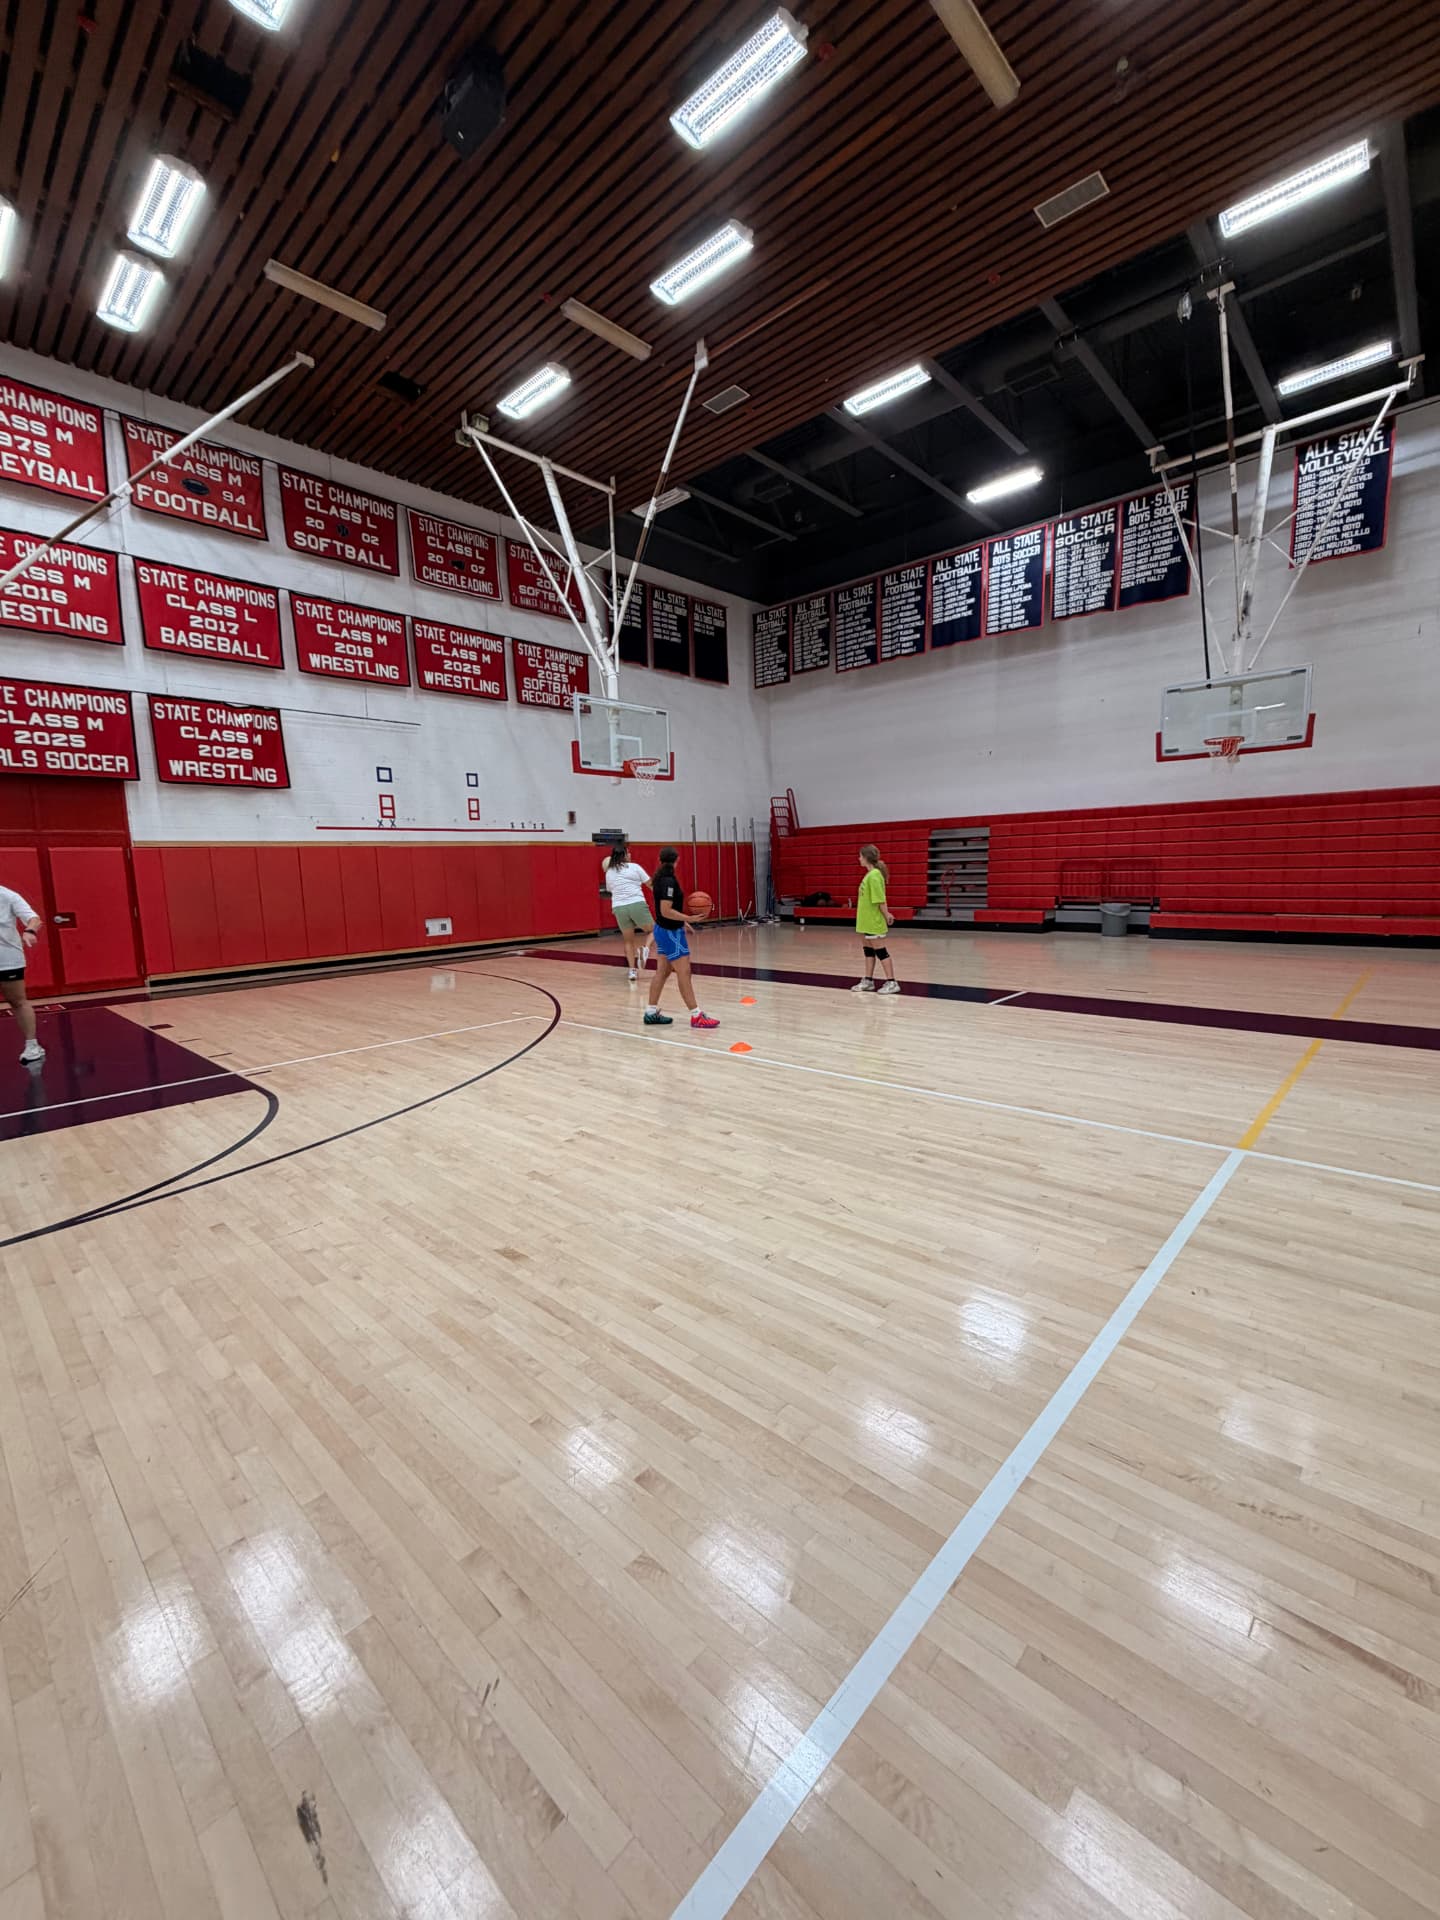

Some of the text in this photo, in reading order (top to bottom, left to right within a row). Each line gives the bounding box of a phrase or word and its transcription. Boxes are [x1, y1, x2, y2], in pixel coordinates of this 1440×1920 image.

[0, 386, 97, 433] HAMPIONS
[56, 427, 73, 445] M
[126, 422, 174, 450] STATE
[1305, 440, 1334, 461] ALL
[0, 451, 104, 496] EYBALL
[228, 473, 242, 487] M
[150, 470, 246, 505] 19 94
[282, 472, 394, 520] STATE CHAMPIONS
[136, 483, 261, 533] FOOTBALL
[304, 497, 377, 529] CLASS L
[1129, 511, 1150, 526] BOYS
[305, 516, 379, 546] 20 02
[418, 517, 489, 551] STATE CHAMPIONS
[1056, 507, 1115, 537] ALL STATE
[993, 540, 1011, 555] ALL
[1014, 529, 1042, 550] STATE
[1055, 523, 1115, 548] SOCCER
[293, 530, 392, 570] SOFTBALL
[426, 535, 485, 561] CLASS L
[510, 544, 536, 563] STATE
[992, 552, 1011, 567] BOYS
[1012, 544, 1040, 561] SOCCER
[427, 552, 486, 574] 20 07
[936, 548, 980, 573] ALL STATE
[73, 574, 91, 590] M
[422, 565, 494, 595] CHEERLEADING
[884, 566, 925, 587] ALL STATE
[932, 562, 982, 584] FOOTBALL
[4, 581, 68, 605] 2016
[139, 566, 276, 609] STATE CHAMPIONS
[654, 589, 686, 607] ALL STATE
[838, 583, 874, 603] ALL STATE
[885, 579, 923, 596] FOOTBALL
[166, 593, 257, 623] CLASS L
[694, 603, 724, 619] ALL STATE
[839, 596, 872, 612] FOOTBALL
[0, 600, 108, 635] ESTLING
[189, 615, 239, 635] 2017
[295, 600, 402, 634] STATE CHAMPIONS
[160, 626, 269, 660] BASEBALL
[316, 623, 388, 646] CLASS M
[415, 624, 503, 653] STATE CHAMPIONS
[334, 642, 374, 658] 2018
[431, 643, 491, 665] CLASS M
[518, 643, 584, 667] STATE CHAMPIONS
[308, 653, 400, 680] WRESTLING
[443, 660, 481, 675] 2025
[527, 657, 576, 676] CLASS M
[537, 669, 569, 683] 2025
[424, 670, 500, 695] WRESTLING
[24, 688, 127, 715] CHAMPIONS
[521, 689, 560, 706] RECORD
[86, 716, 104, 731] M
[154, 702, 278, 731] STATE CHAMPIONS
[14, 730, 87, 748] 2025
[180, 725, 249, 743] CLASS
[45, 751, 129, 773] SOCCER
[198, 744, 254, 760] 2026
[168, 759, 278, 783] WRESTLING
